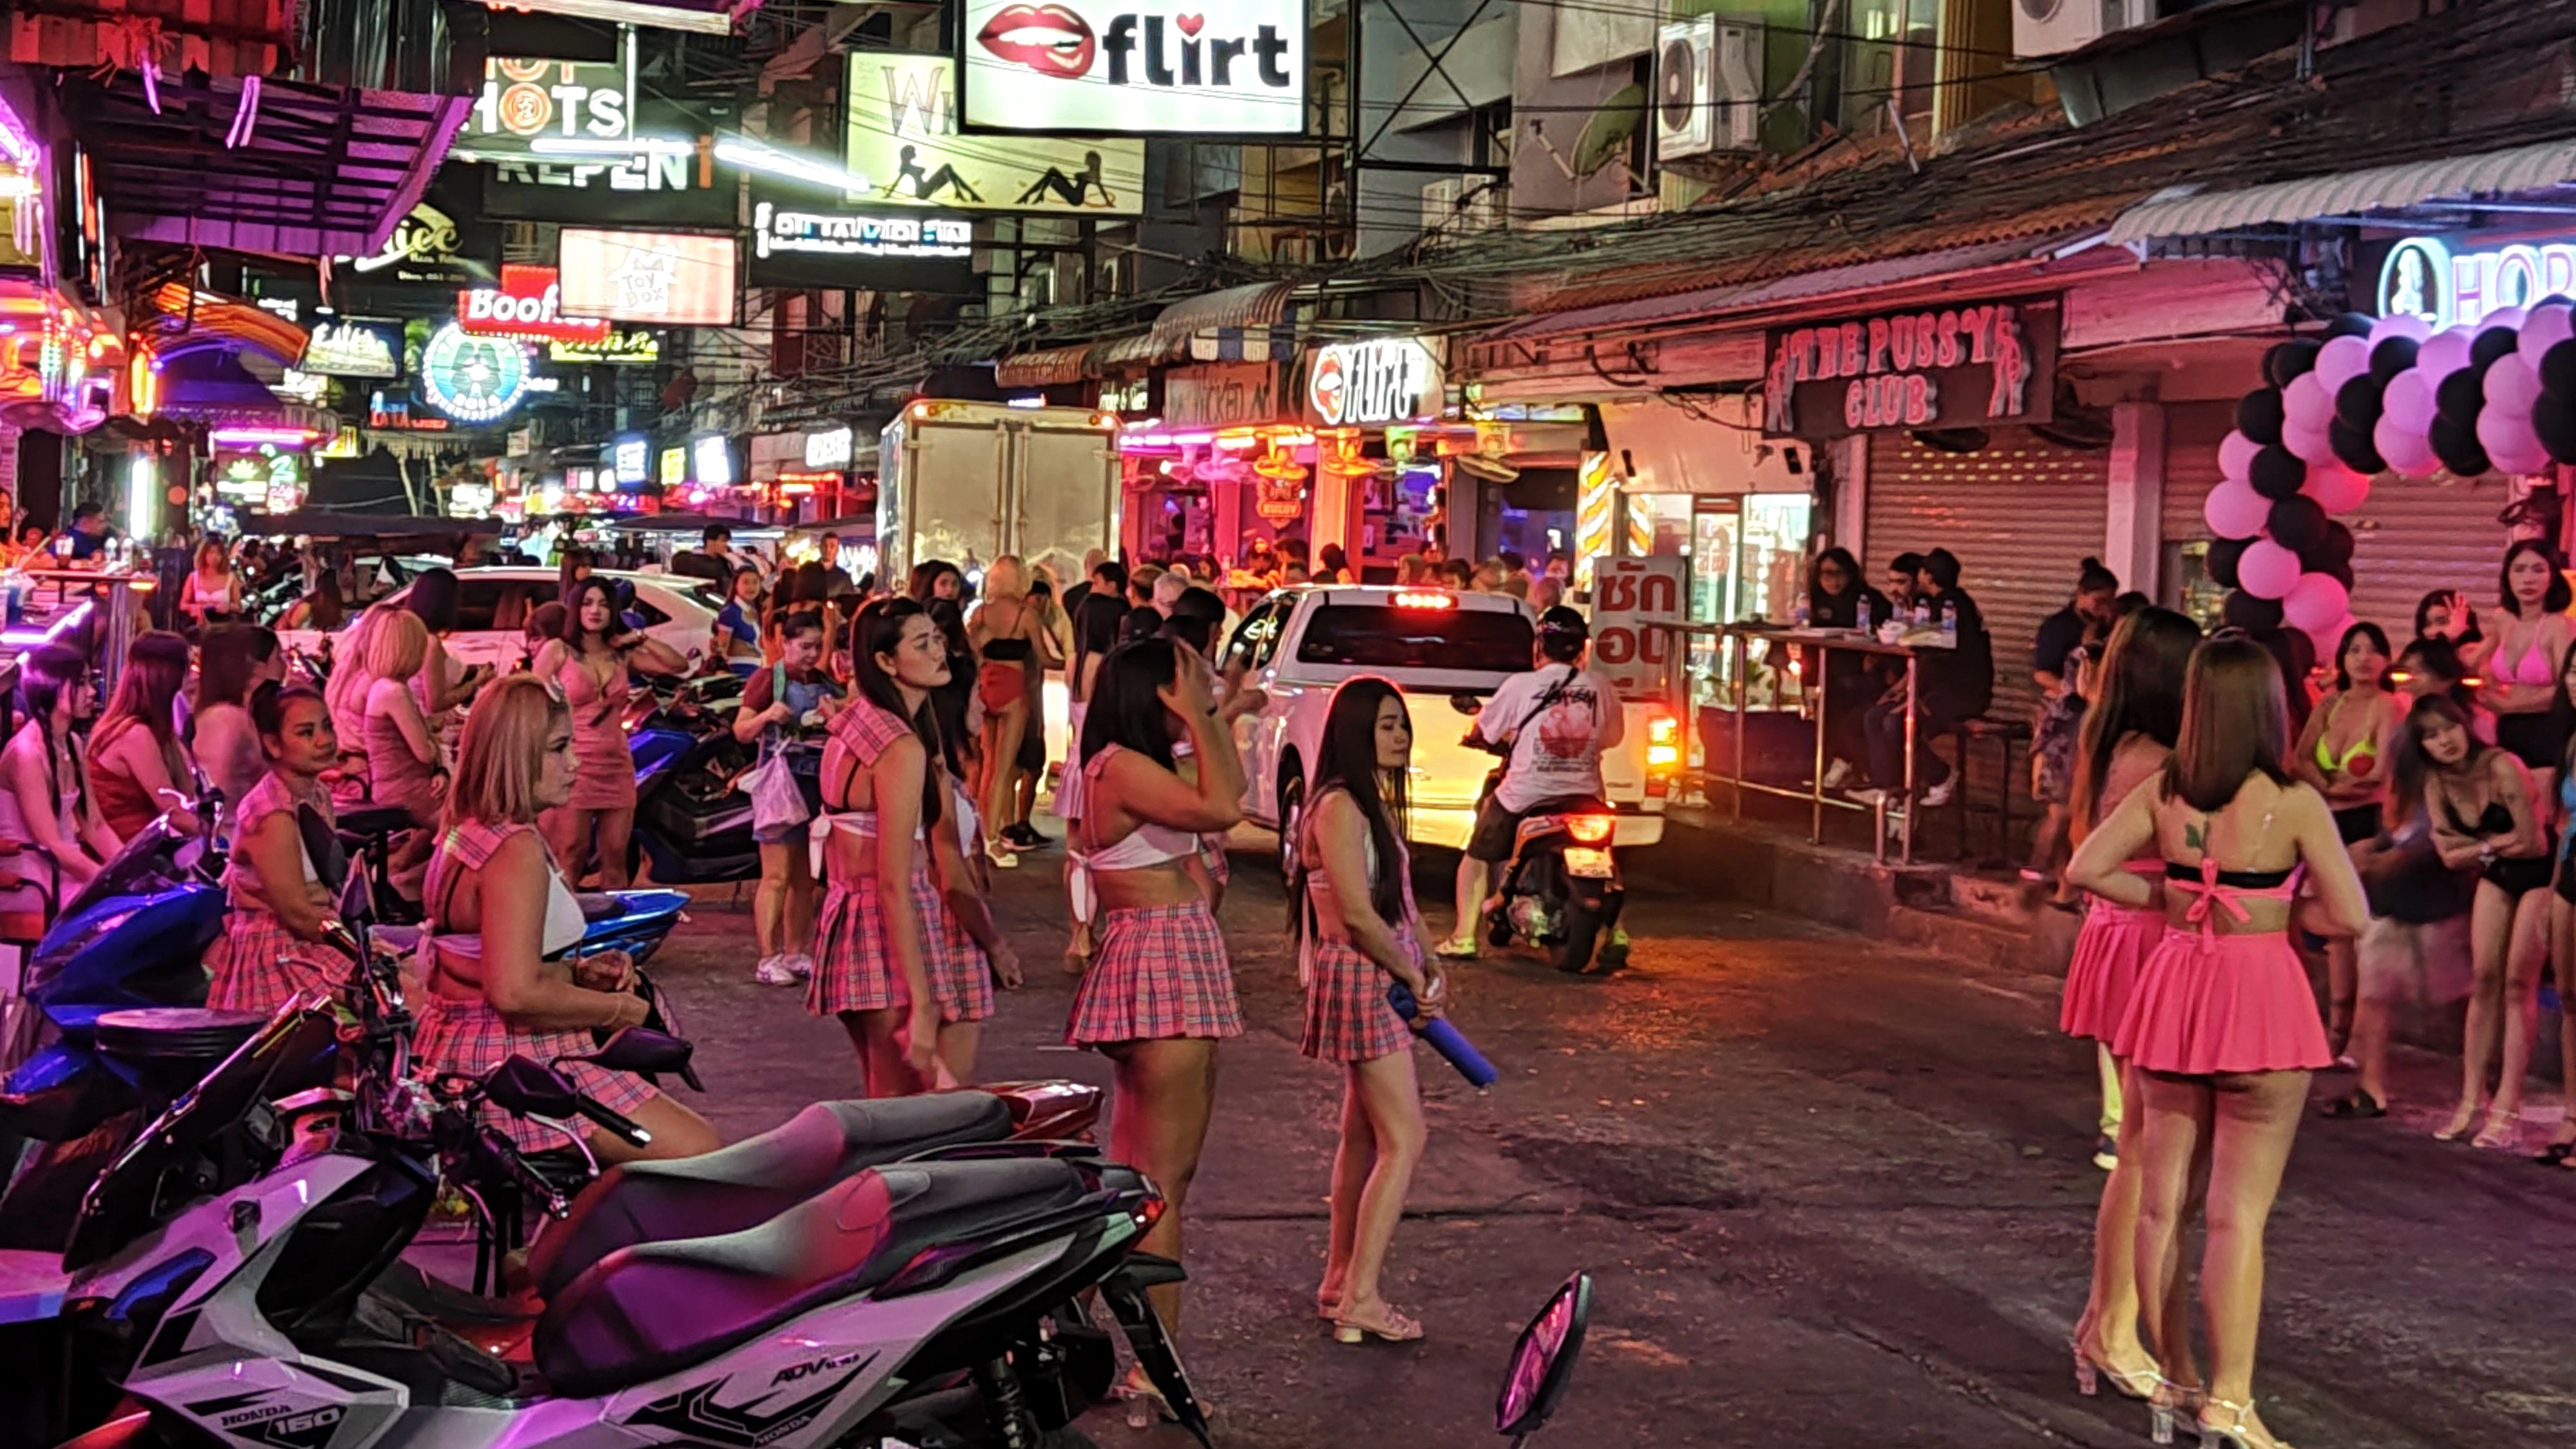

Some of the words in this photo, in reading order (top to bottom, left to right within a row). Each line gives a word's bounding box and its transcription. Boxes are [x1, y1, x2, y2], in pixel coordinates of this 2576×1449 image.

[1101, 13, 1291, 88] flirt
[1790, 322, 1861, 381] THE
[1868, 305, 1996, 373] PUSSY
[1346, 343, 1411, 422] flirt
[1844, 374, 1929, 430] CLUB
[770, 1357, 828, 1387] ADV
[222, 1404, 292, 1426] HONDA
[274, 1407, 340, 1435] 160
[754, 1415, 813, 1447] HONDA
